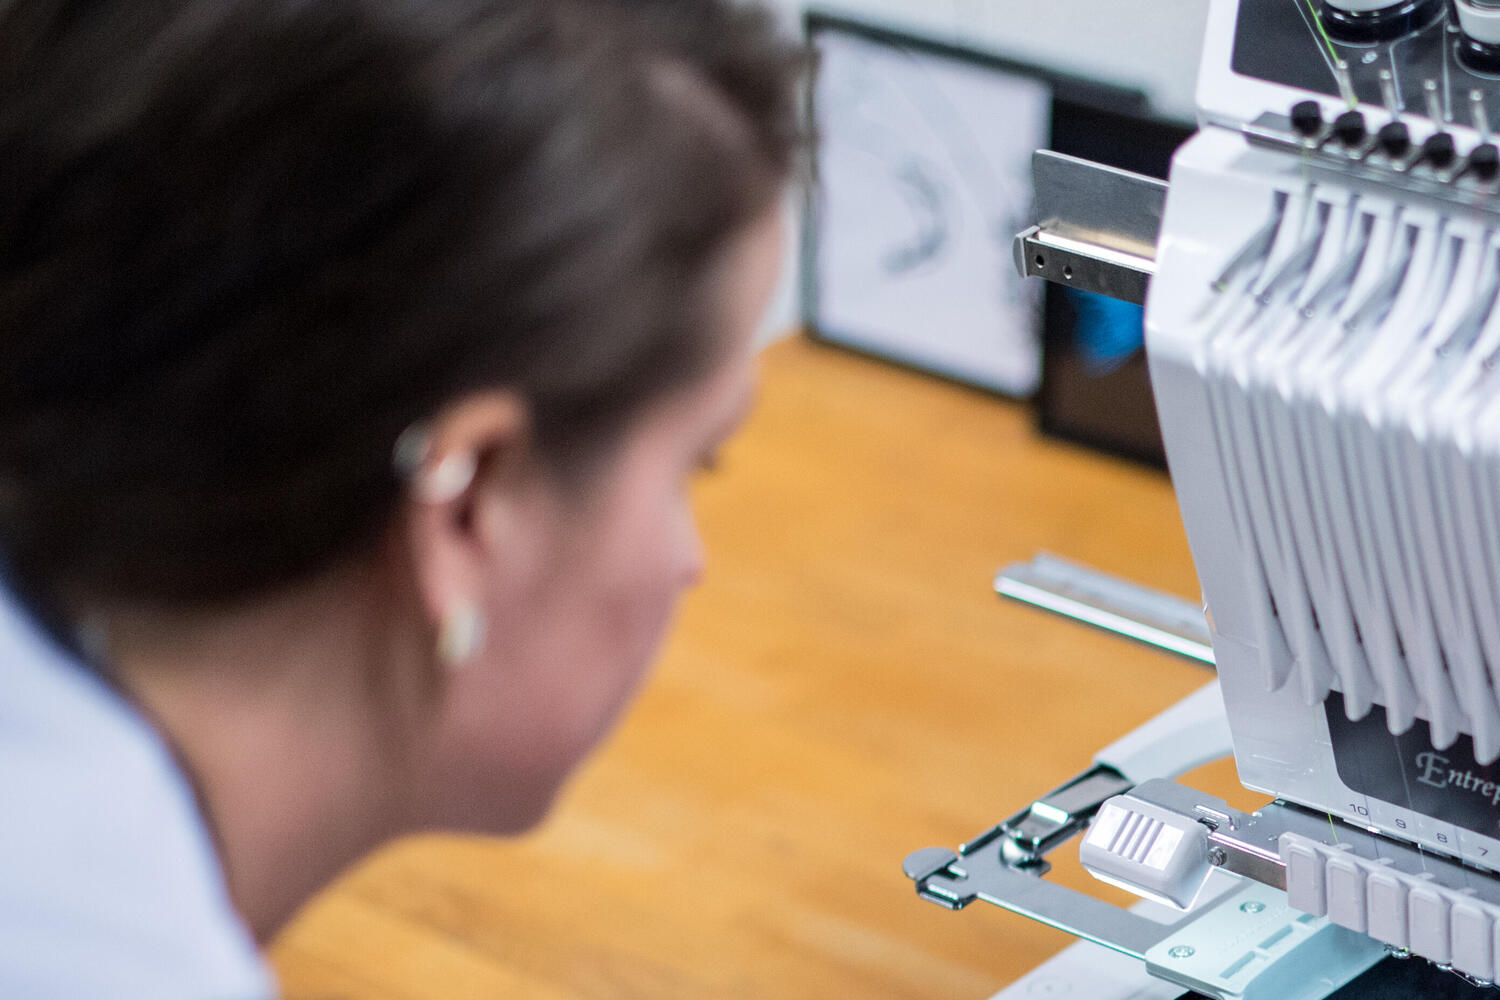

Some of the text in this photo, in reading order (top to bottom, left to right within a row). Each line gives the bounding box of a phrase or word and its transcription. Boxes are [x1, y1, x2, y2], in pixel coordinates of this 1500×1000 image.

[1348, 803, 1369, 817] 10
[1395, 818, 1407, 829] 9
[1436, 832, 1449, 844] 8
[1478, 846, 1489, 857] 7
